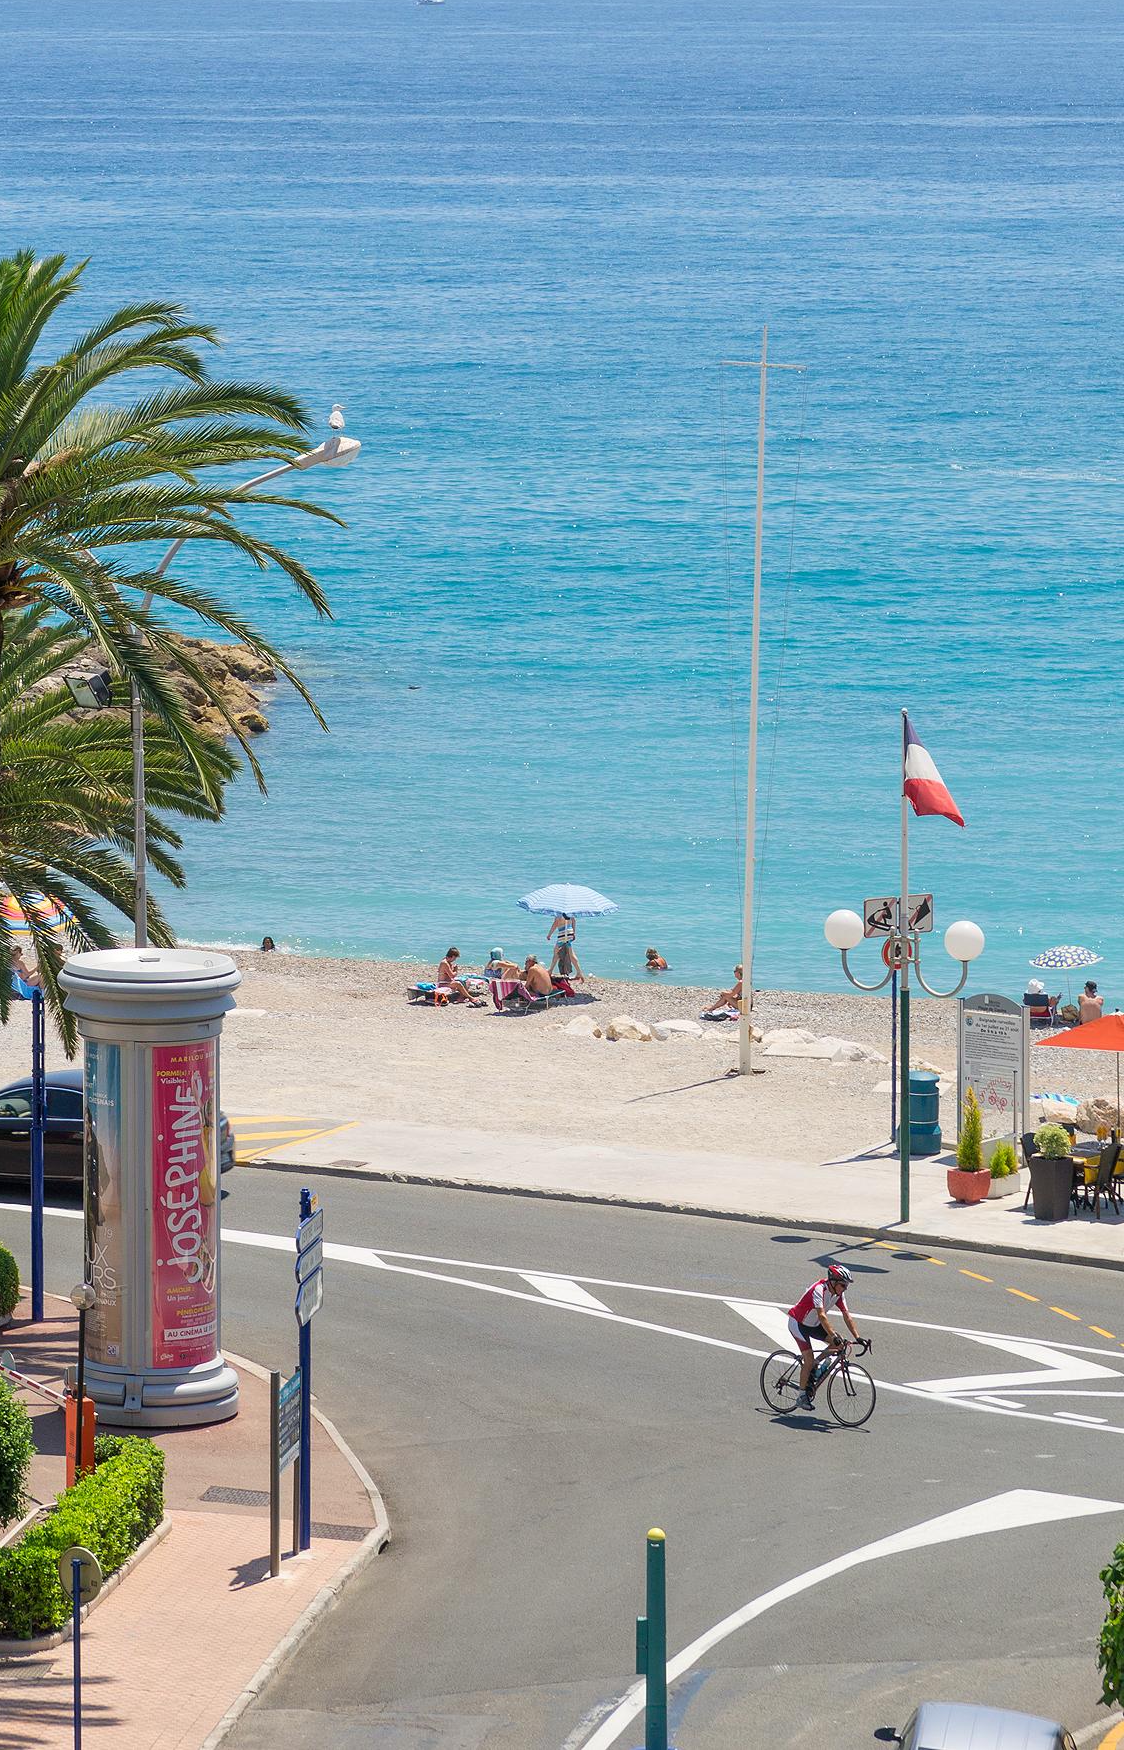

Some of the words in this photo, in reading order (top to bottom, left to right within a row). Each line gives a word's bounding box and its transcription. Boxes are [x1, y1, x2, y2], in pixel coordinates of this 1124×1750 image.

[170, 1054, 204, 1063] MARILOU
[167, 1330, 178, 1338] AU
[179, 1327, 203, 1337] CINÉMA
